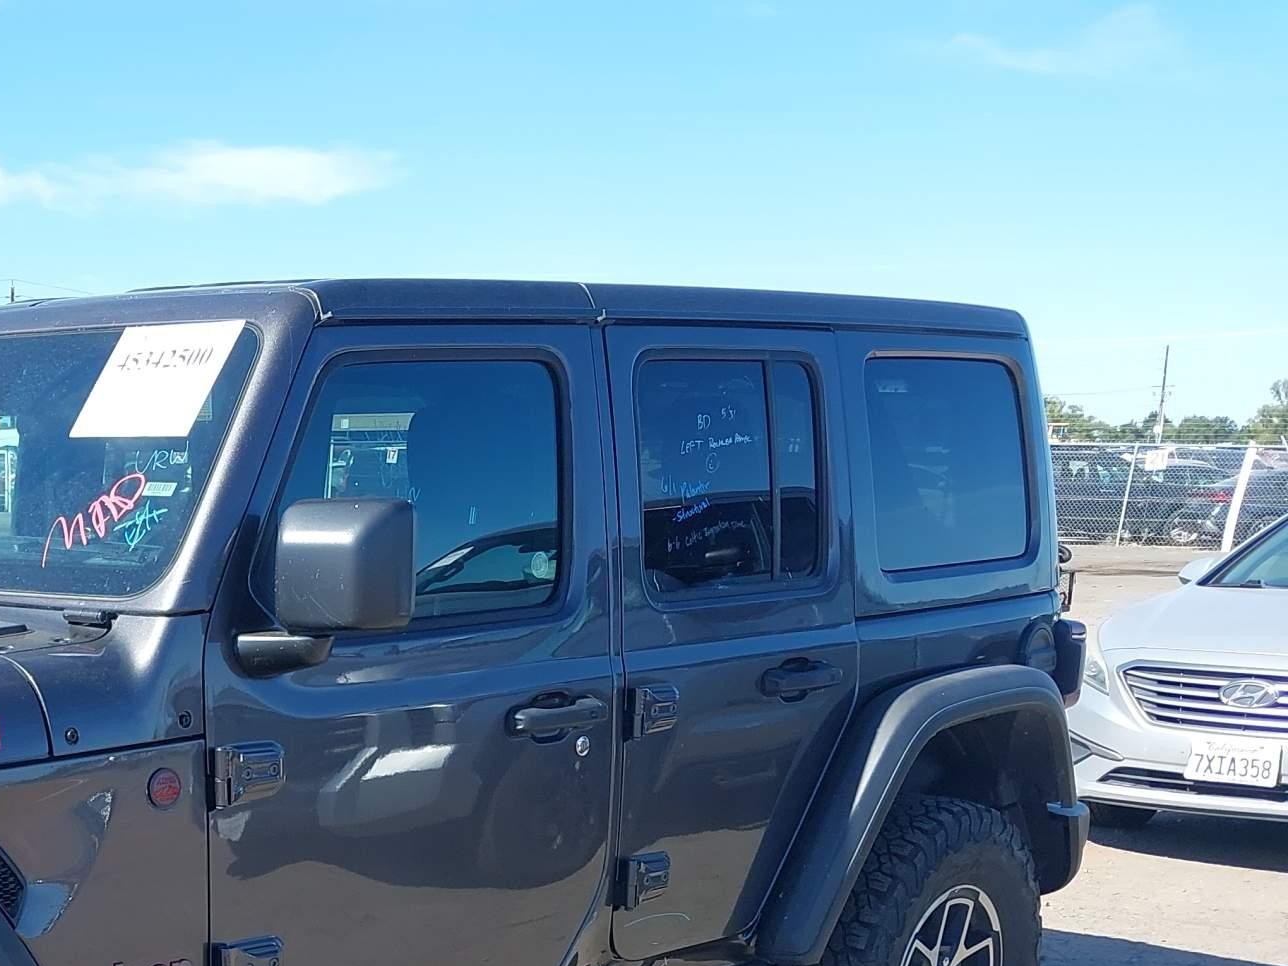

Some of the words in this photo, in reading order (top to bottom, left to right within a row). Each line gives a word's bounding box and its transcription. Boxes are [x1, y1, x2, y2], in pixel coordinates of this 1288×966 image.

[697, 413, 711, 430] BD
[680, 440, 704, 455] LEFT
[1194, 753, 1272, 779] 7XIA358
